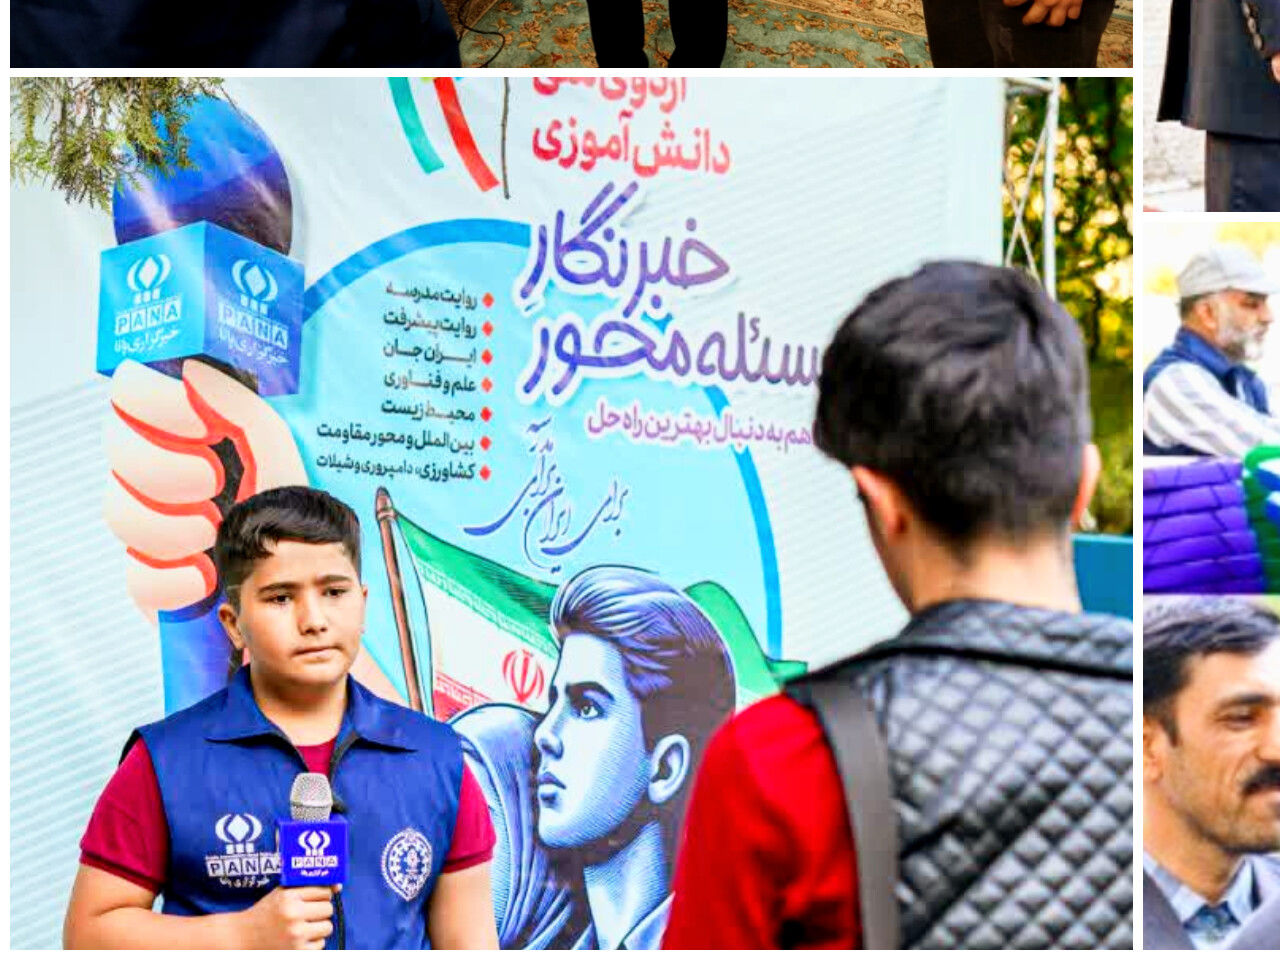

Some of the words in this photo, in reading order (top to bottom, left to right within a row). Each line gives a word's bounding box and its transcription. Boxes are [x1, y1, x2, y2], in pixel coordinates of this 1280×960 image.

[114, 297, 182, 336] PANA
[218, 301, 289, 351] PANA
[522, 318, 692, 396] محور
[697, 311, 819, 387] سئله
[206, 851, 280, 877] PANA
